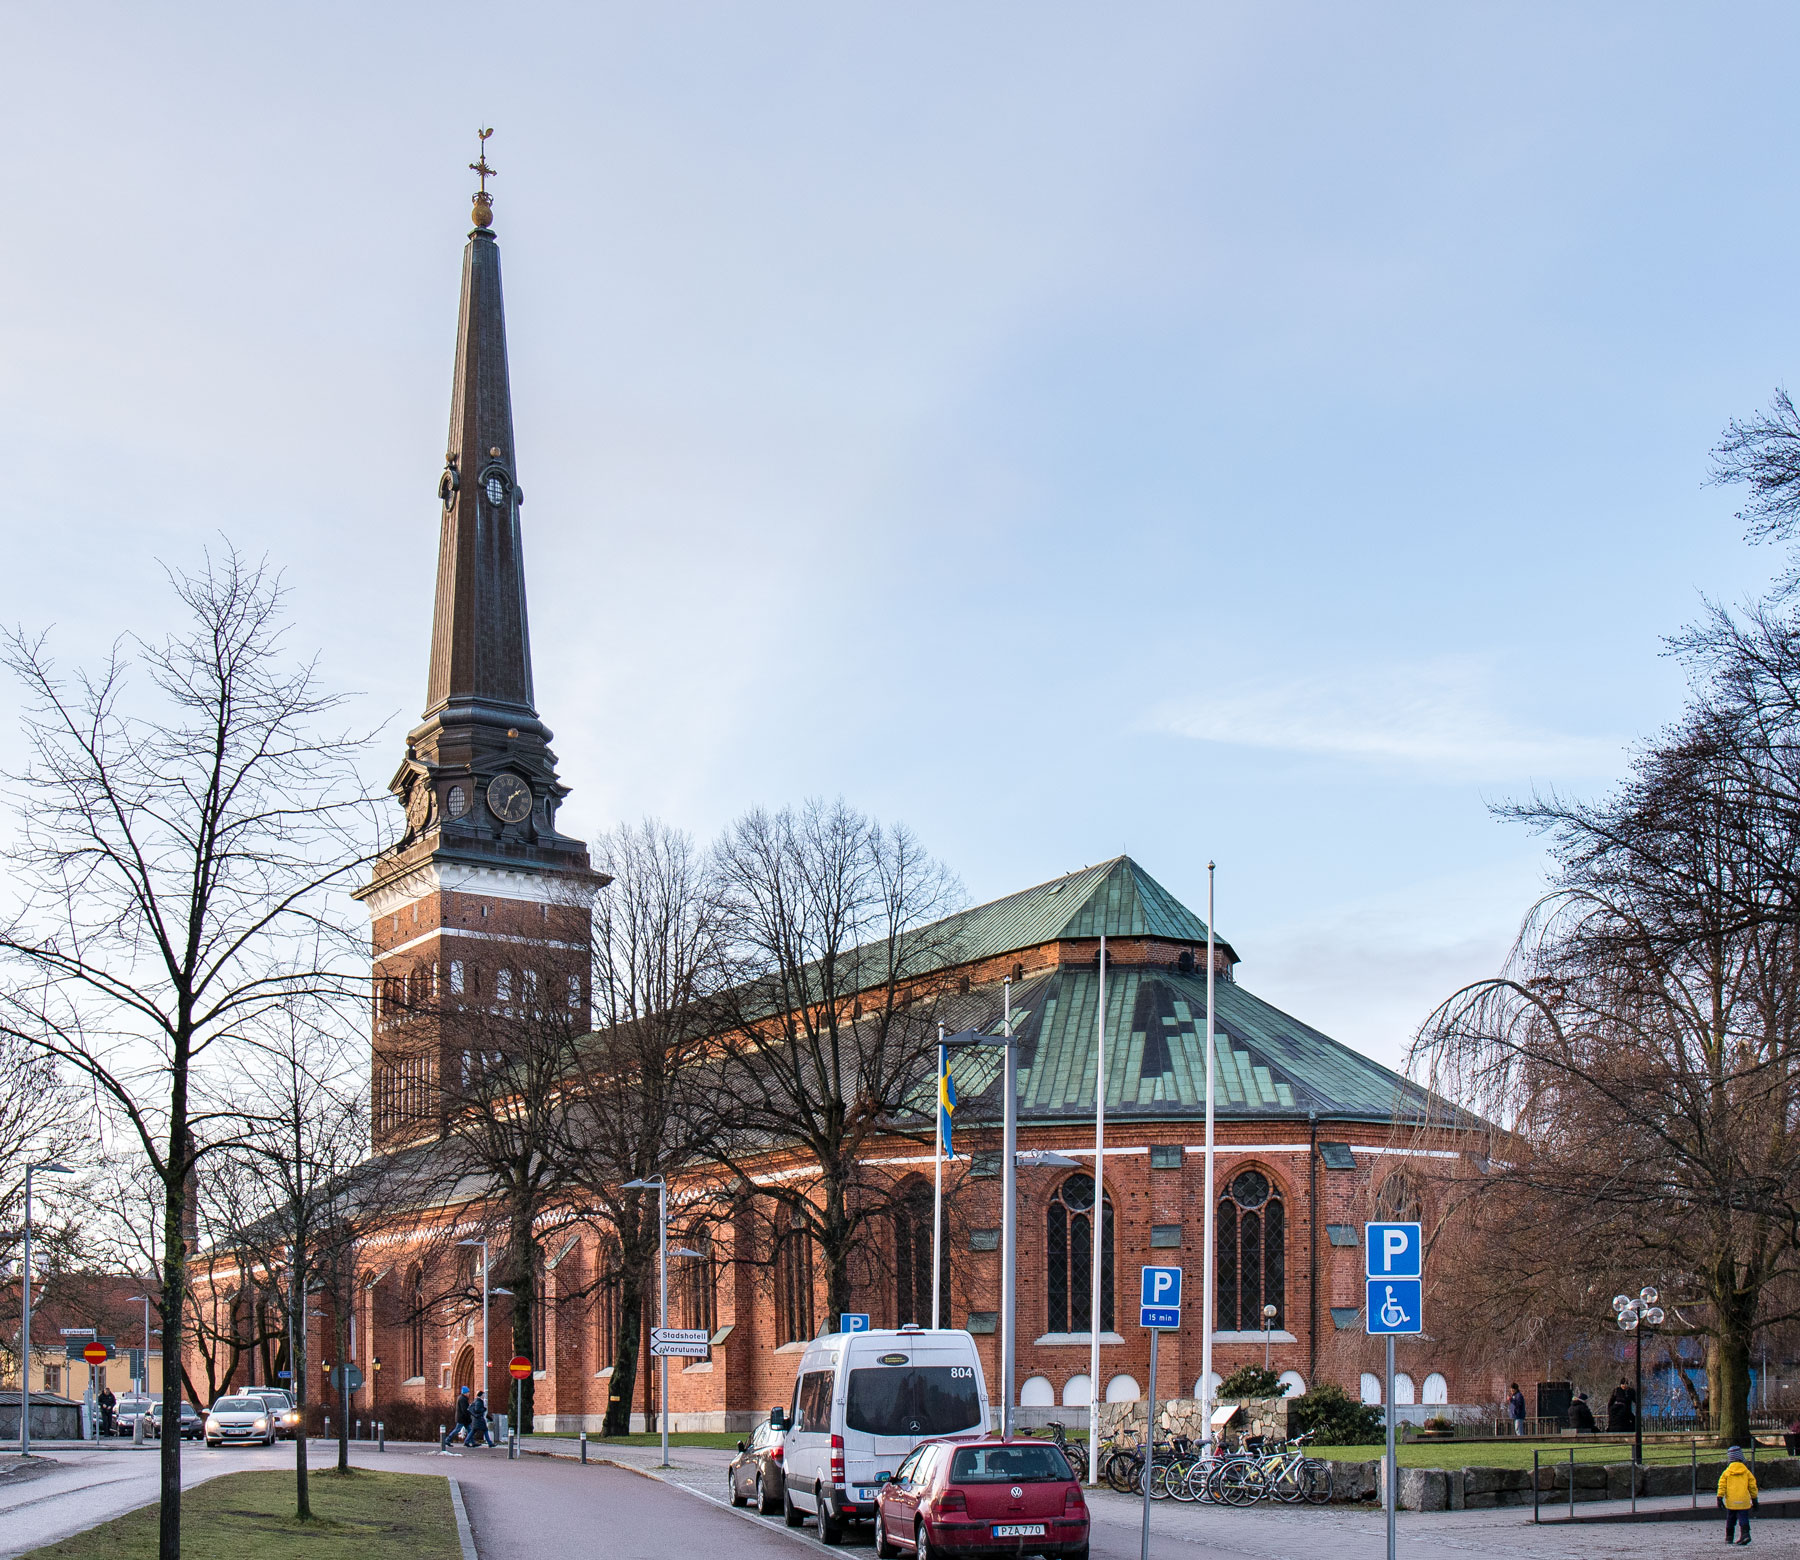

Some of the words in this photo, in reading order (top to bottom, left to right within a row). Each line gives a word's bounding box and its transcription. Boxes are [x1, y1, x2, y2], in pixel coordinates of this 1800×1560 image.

[1383, 1229, 1409, 1271] P
[1153, 1271, 1173, 1303] P
[1148, 1313, 1157, 1321] 15
[1159, 1313, 1173, 1322] min
[849, 1316, 863, 1332] P
[662, 1331, 706, 1340] Stadshotell
[664, 1345, 706, 1354] Varutunnel
[950, 1367, 973, 1378] 804
[1001, 1526, 1020, 1536] PZA
[1022, 1525, 1041, 1535] 770
